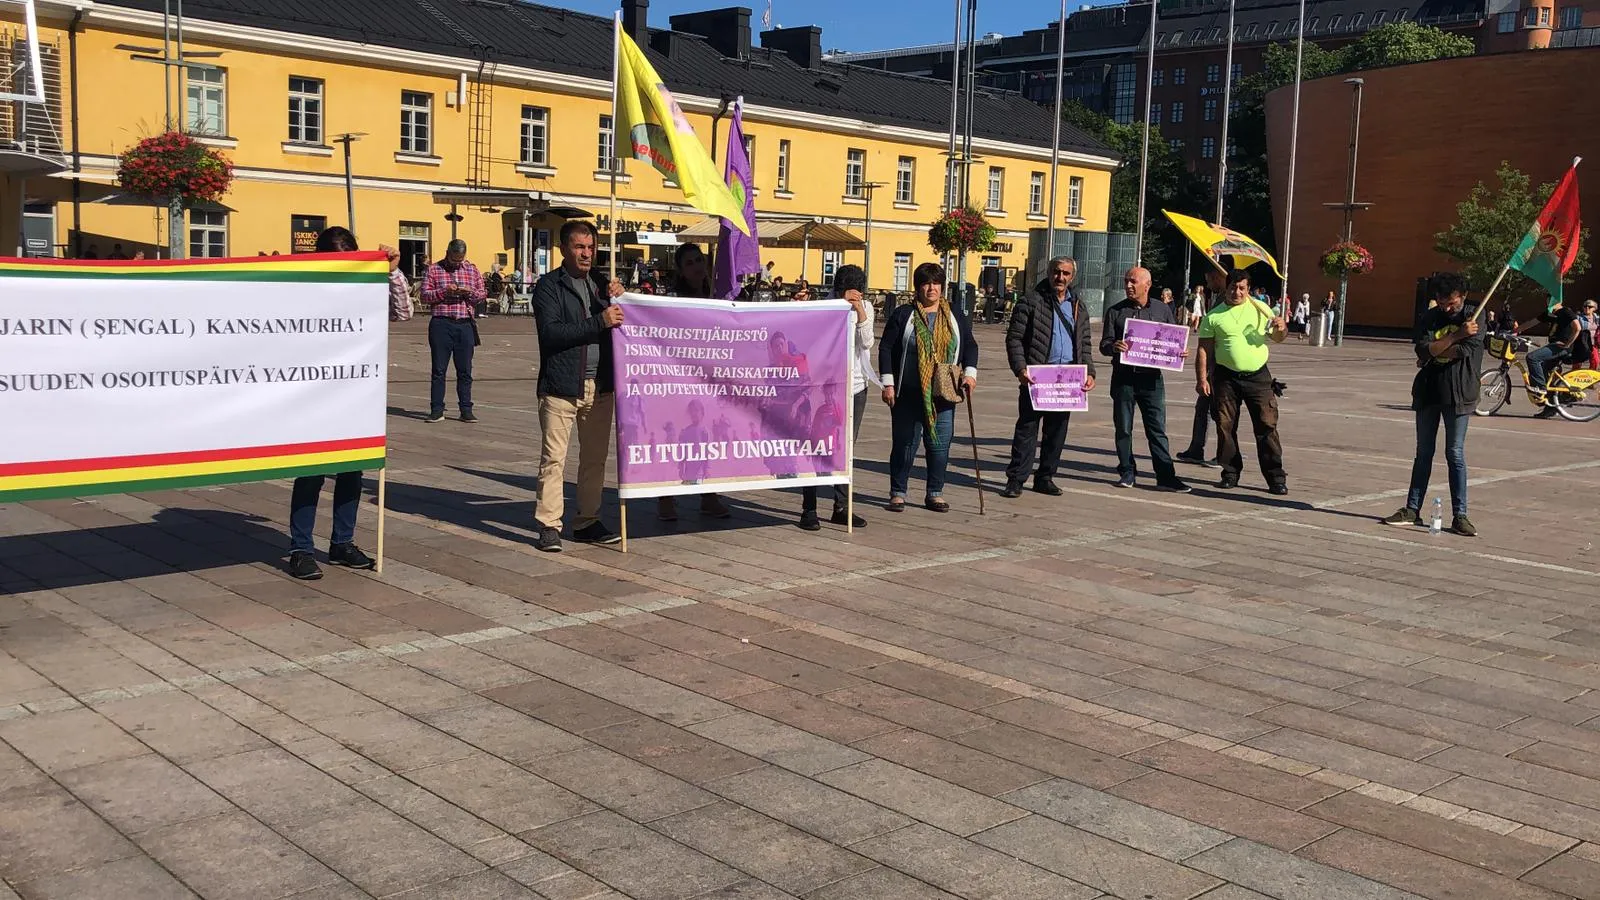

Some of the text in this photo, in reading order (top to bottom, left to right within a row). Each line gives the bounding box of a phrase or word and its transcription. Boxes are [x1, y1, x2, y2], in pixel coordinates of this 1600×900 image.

[596, 214, 655, 232] HNRY'S
[0, 318, 73, 335] JARIN
[94, 318, 184, 338] ŞENGAL
[206, 318, 355, 334] KANSANMURHA
[623, 325, 768, 343] TERRORISTIJÄRJESTÖ
[625, 344, 734, 360] ISISIN UHREIKSI
[1128, 351, 1149, 359] NEVER
[0, 373, 94, 391] SUUDEN
[101, 365, 258, 389] OSOITUSPÄIVÄ
[262, 364, 370, 383] YAZIDEILLE
[625, 364, 799, 380] JOUTUNEITA, RAISKATTUJA
[626, 383, 777, 398] JA ORJUTETTUJA NAISIA
[628, 435, 833, 465] EI TULISI UNOHTAA!
